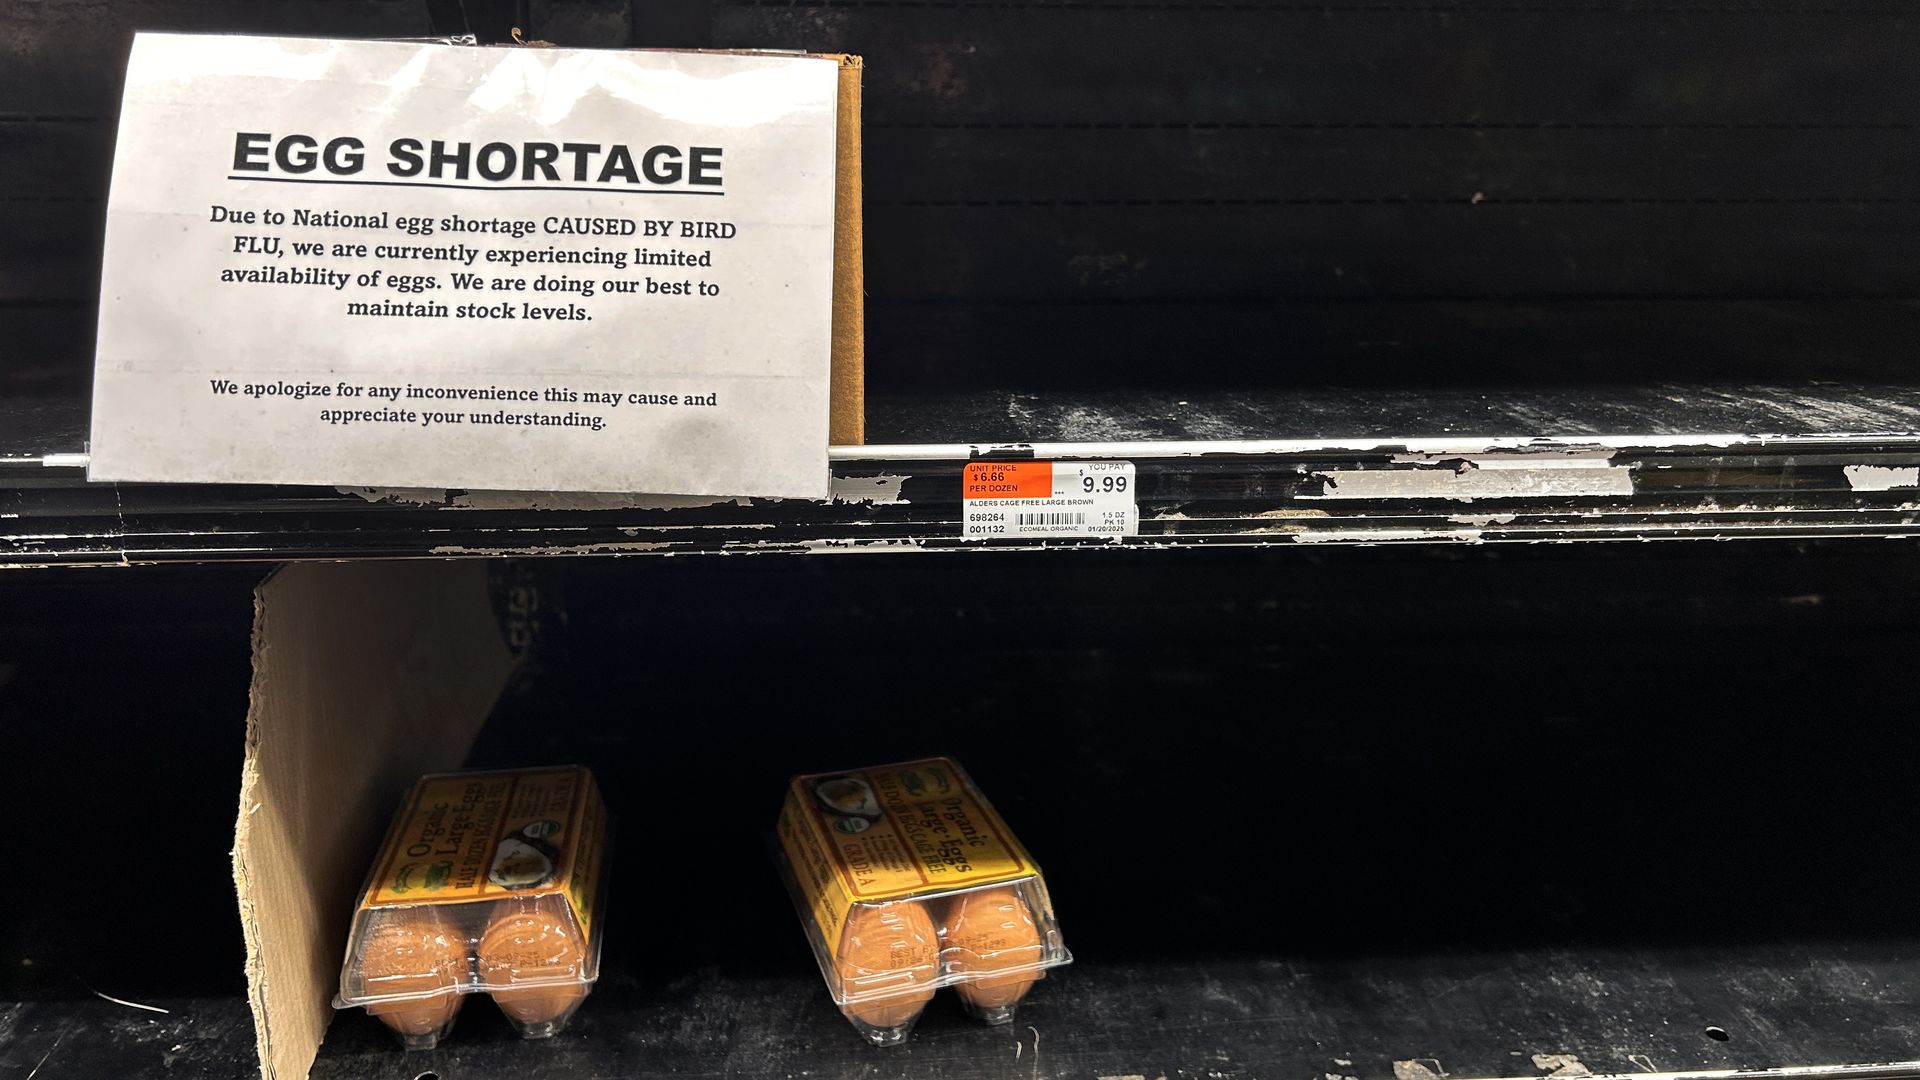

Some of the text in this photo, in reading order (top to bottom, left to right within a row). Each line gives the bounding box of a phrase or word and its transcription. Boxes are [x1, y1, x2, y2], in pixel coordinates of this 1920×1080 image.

[232, 131, 723, 187] EGG SHORTAGE
[209, 205, 737, 240] Due to National egg shortage CAUSED BY BIRD
[232, 235, 712, 270] FLU, we are currently experiencing limited
[220, 265, 720, 298] availability of eggs. We are doing our best to
[346, 299, 593, 322] maintain stock levels.
[209, 379, 718, 408] We apologize for any inconvenience this may cause and
[319, 407, 607, 432] appreciate your understanding.
[992, 464, 1017, 472] PRICE
[1088, 463, 1107, 471] YOU
[989, 484, 1018, 492] DOZEN
[1083, 476, 1127, 493] 9.99
[969, 513, 1005, 522] 698264
[969, 525, 1005, 534] 001132
[942, 798, 987, 848] Organic
